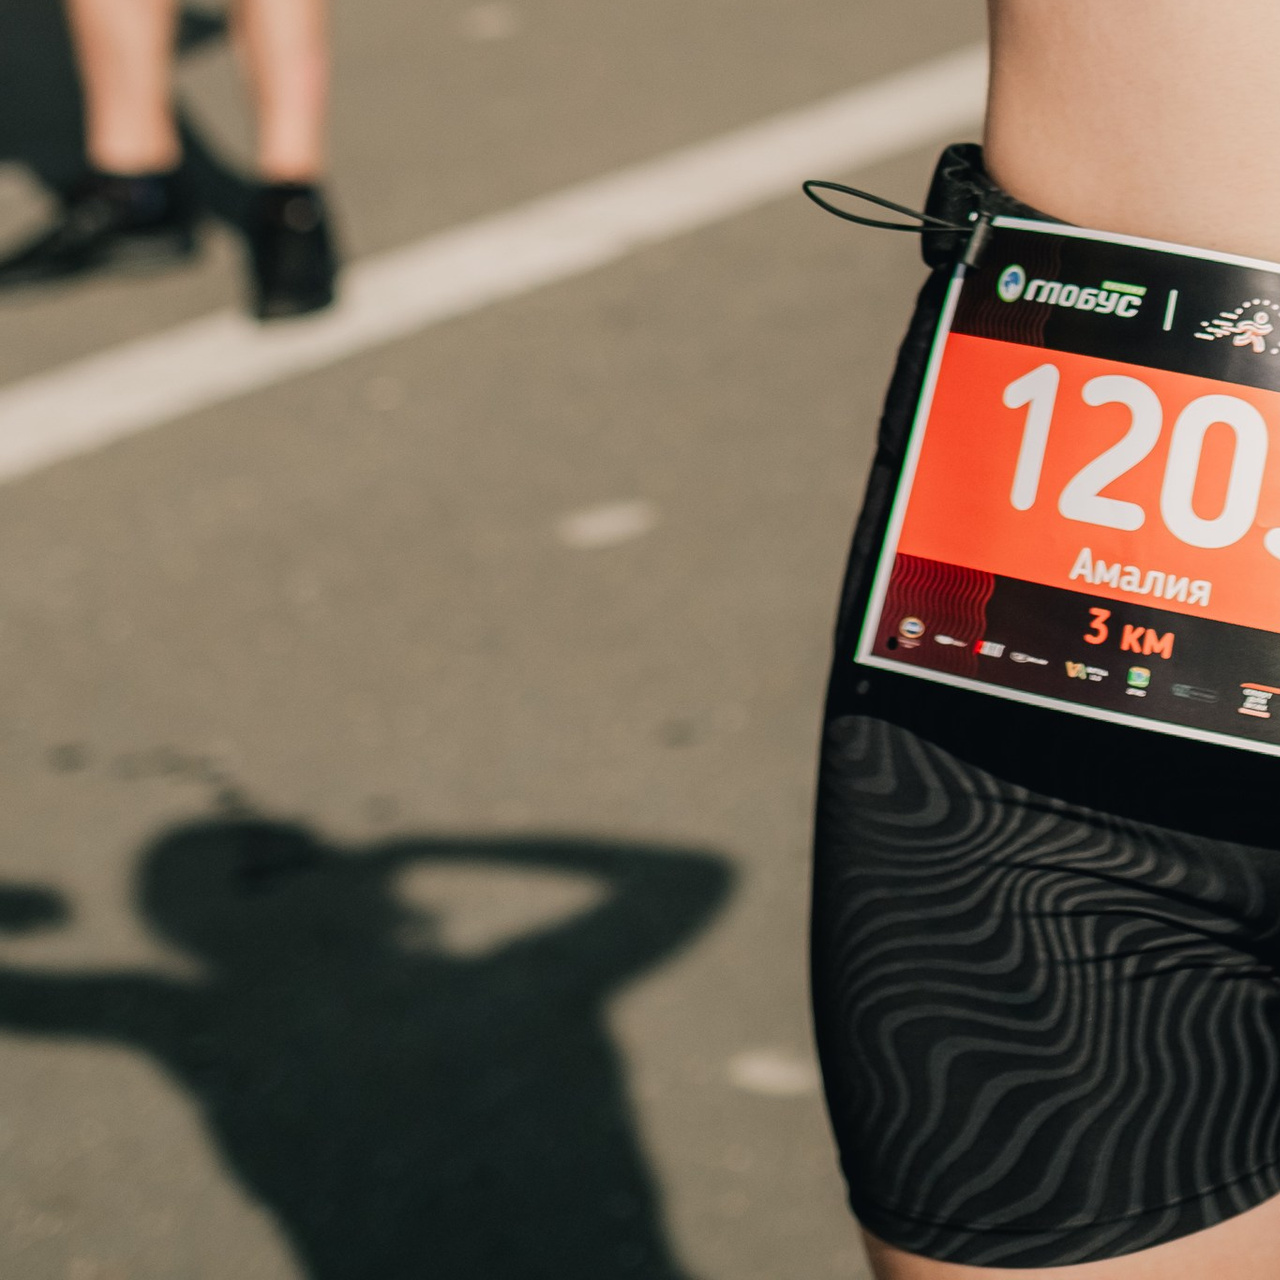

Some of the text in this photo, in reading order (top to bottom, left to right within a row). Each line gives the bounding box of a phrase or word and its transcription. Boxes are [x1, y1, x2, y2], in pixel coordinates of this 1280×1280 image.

[1024, 279, 1143, 318] ГЛОБУС
[1068, 546, 1213, 608] Амалия
[1083, 607, 1111, 645] 3
